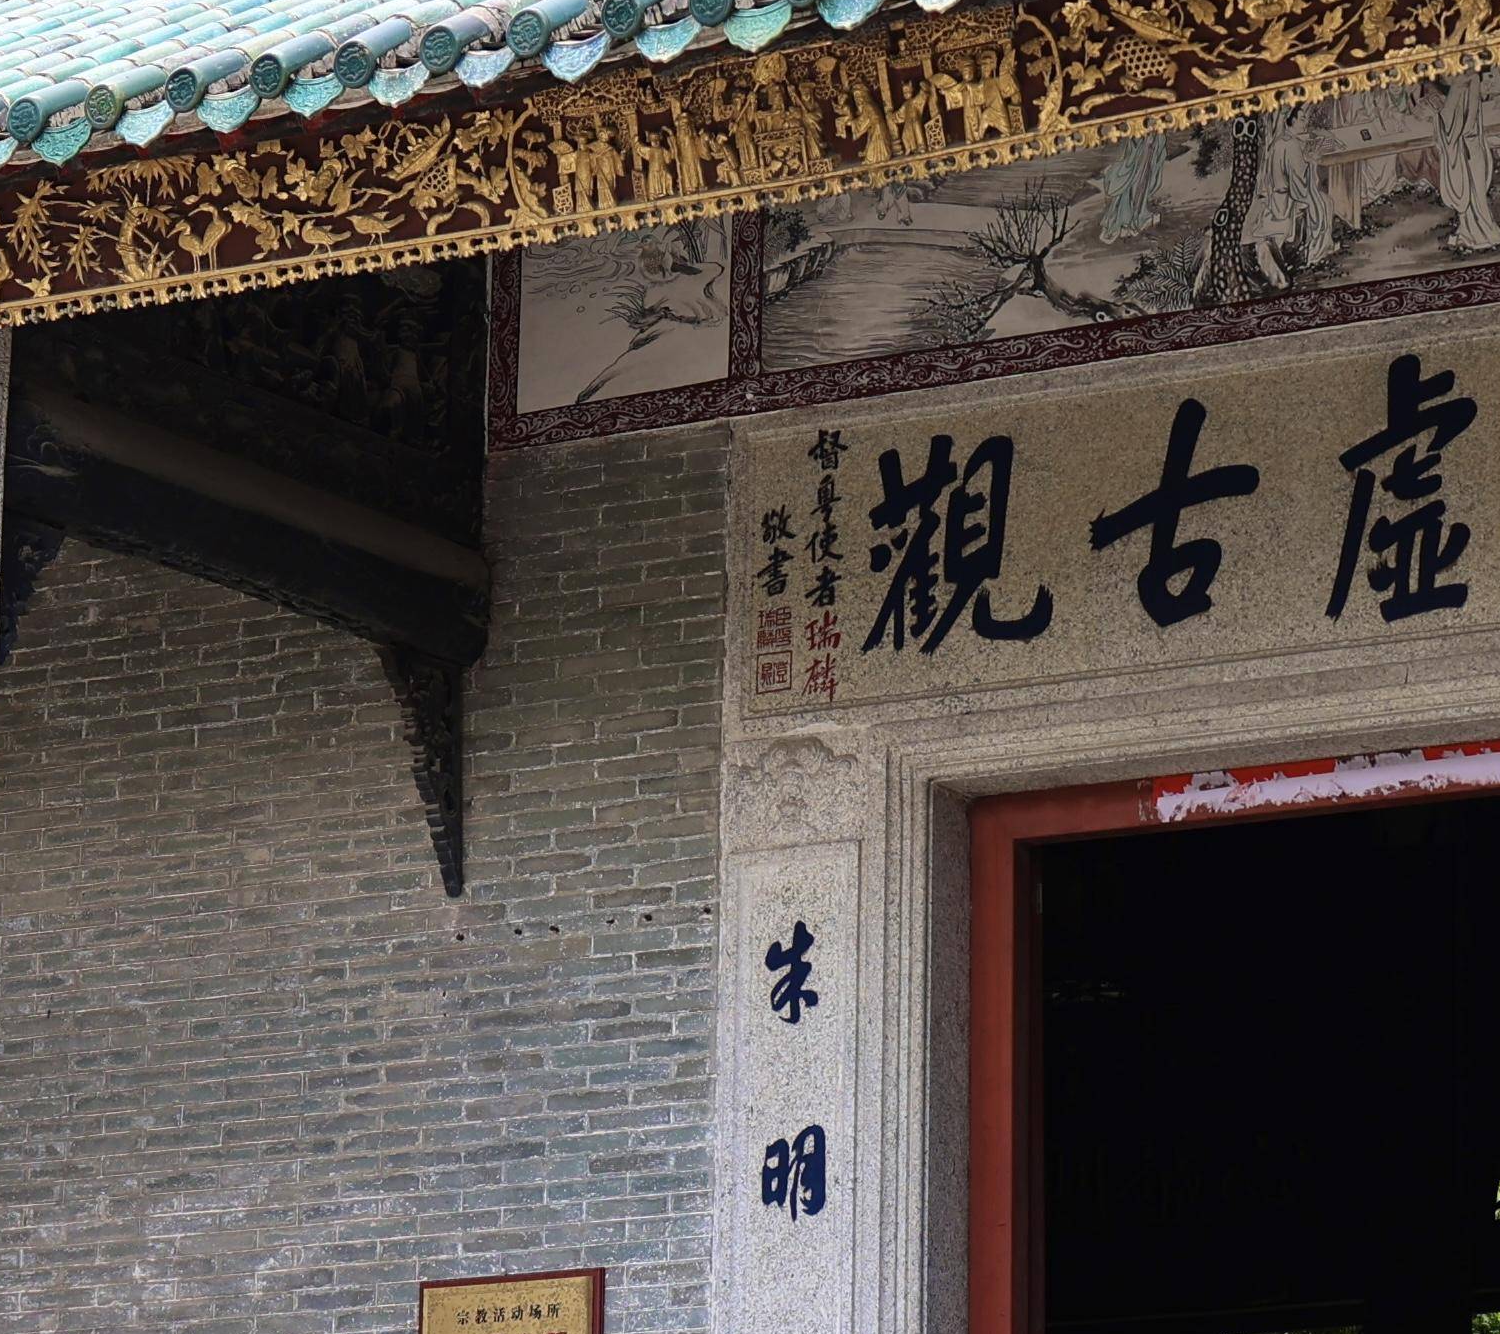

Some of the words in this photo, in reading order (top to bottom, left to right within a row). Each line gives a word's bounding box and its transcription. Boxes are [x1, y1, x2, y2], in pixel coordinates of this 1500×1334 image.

[456, 1303, 562, 1325] 宗教活动场所
